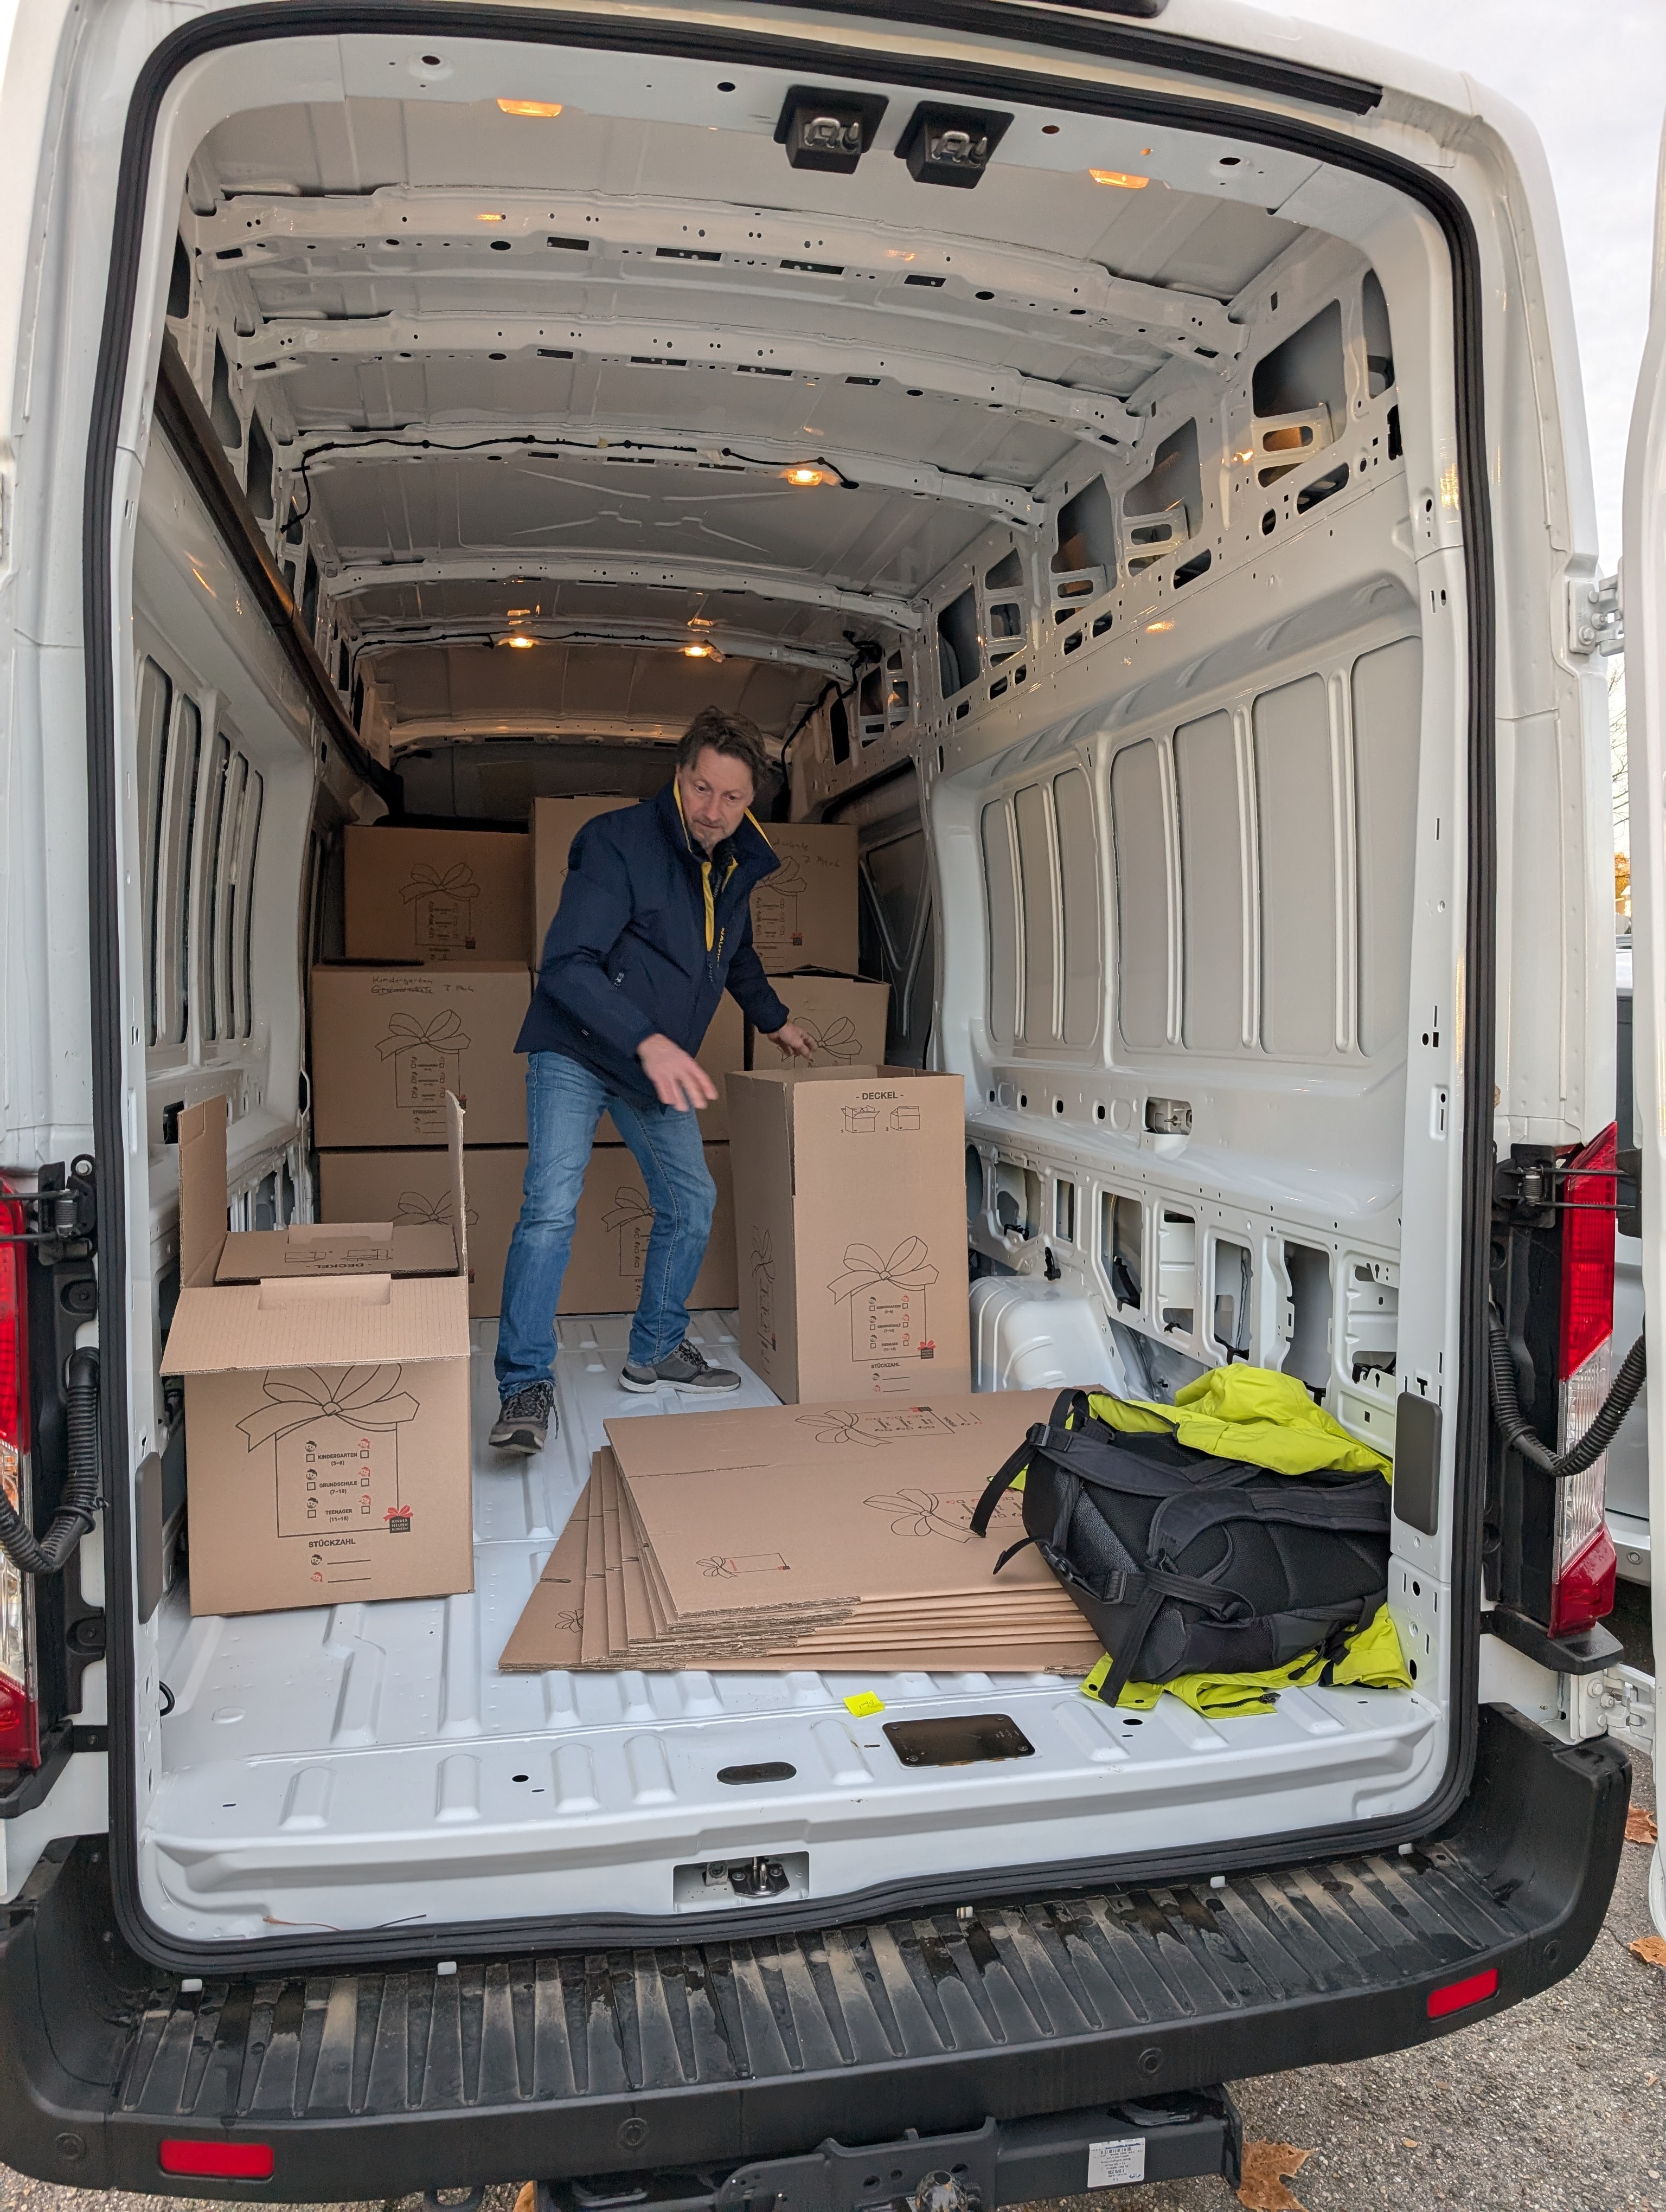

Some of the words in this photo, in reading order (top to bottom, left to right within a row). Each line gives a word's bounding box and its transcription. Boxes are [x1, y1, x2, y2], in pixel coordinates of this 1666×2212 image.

[373, 976, 432, 985] Kindergarten
[862, 1091, 898, 1100] DECKEL
[308, 1538, 356, 1548] STÜCKZAHL
